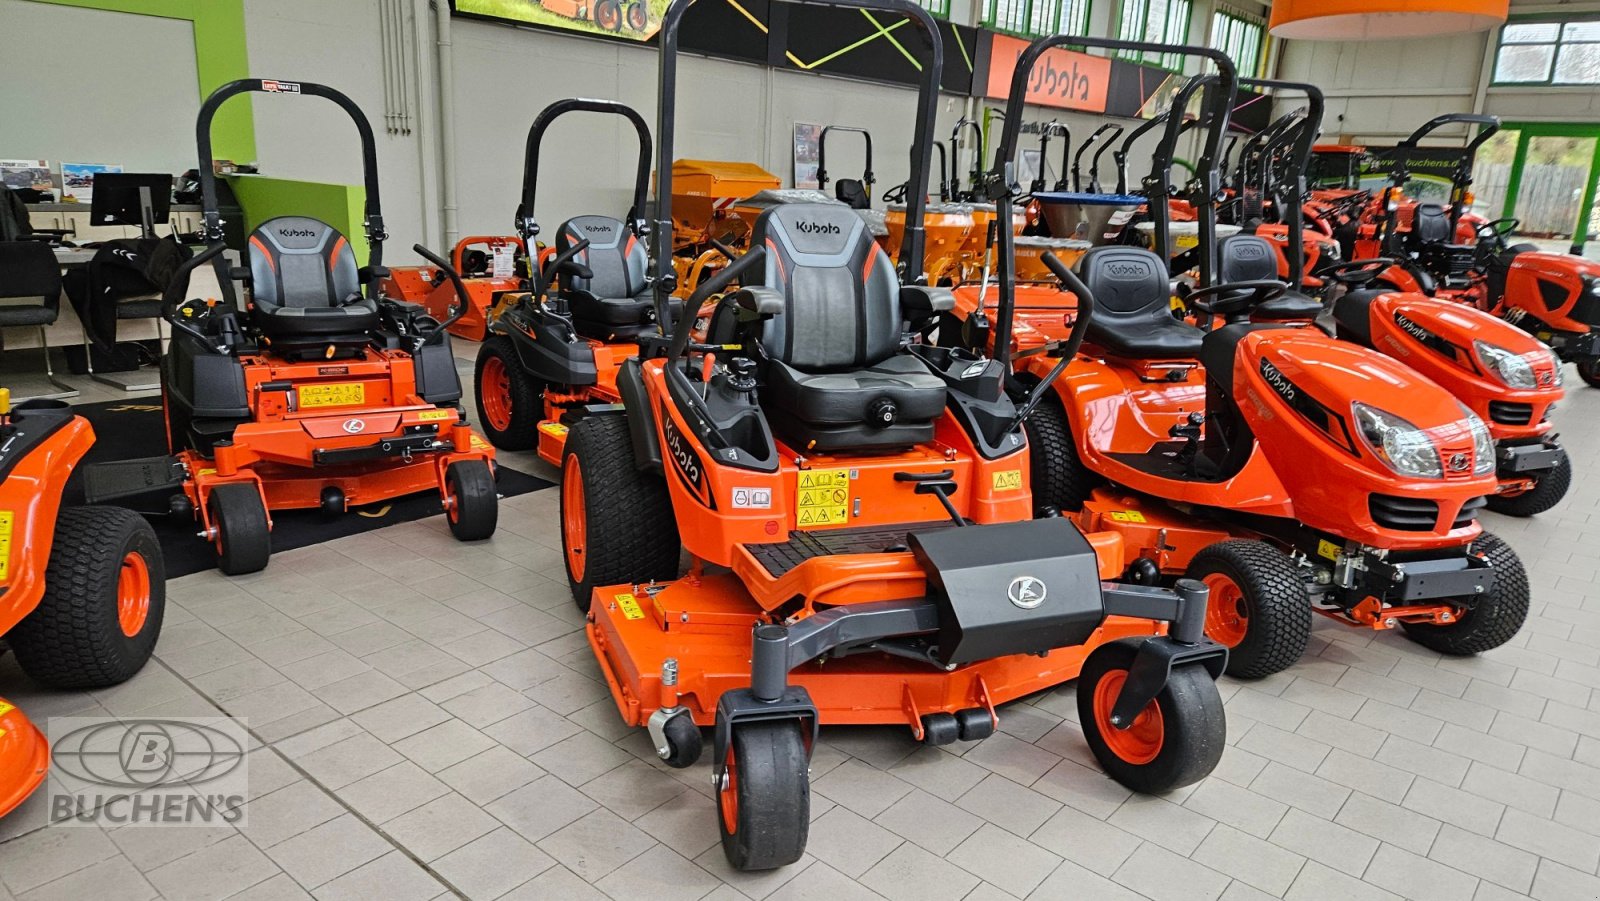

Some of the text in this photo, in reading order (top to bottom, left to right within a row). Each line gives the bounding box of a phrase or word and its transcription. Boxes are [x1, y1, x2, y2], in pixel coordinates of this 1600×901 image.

[1017, 49, 1089, 101] ubota
[279, 229, 315, 237] Kubota
[795, 221, 840, 234] Kubota
[1108, 264, 1144, 275] Kubota
[1397, 315, 1428, 340] Kubota
[1263, 363, 1295, 400] Kubota
[665, 417, 698, 482] Kubota
